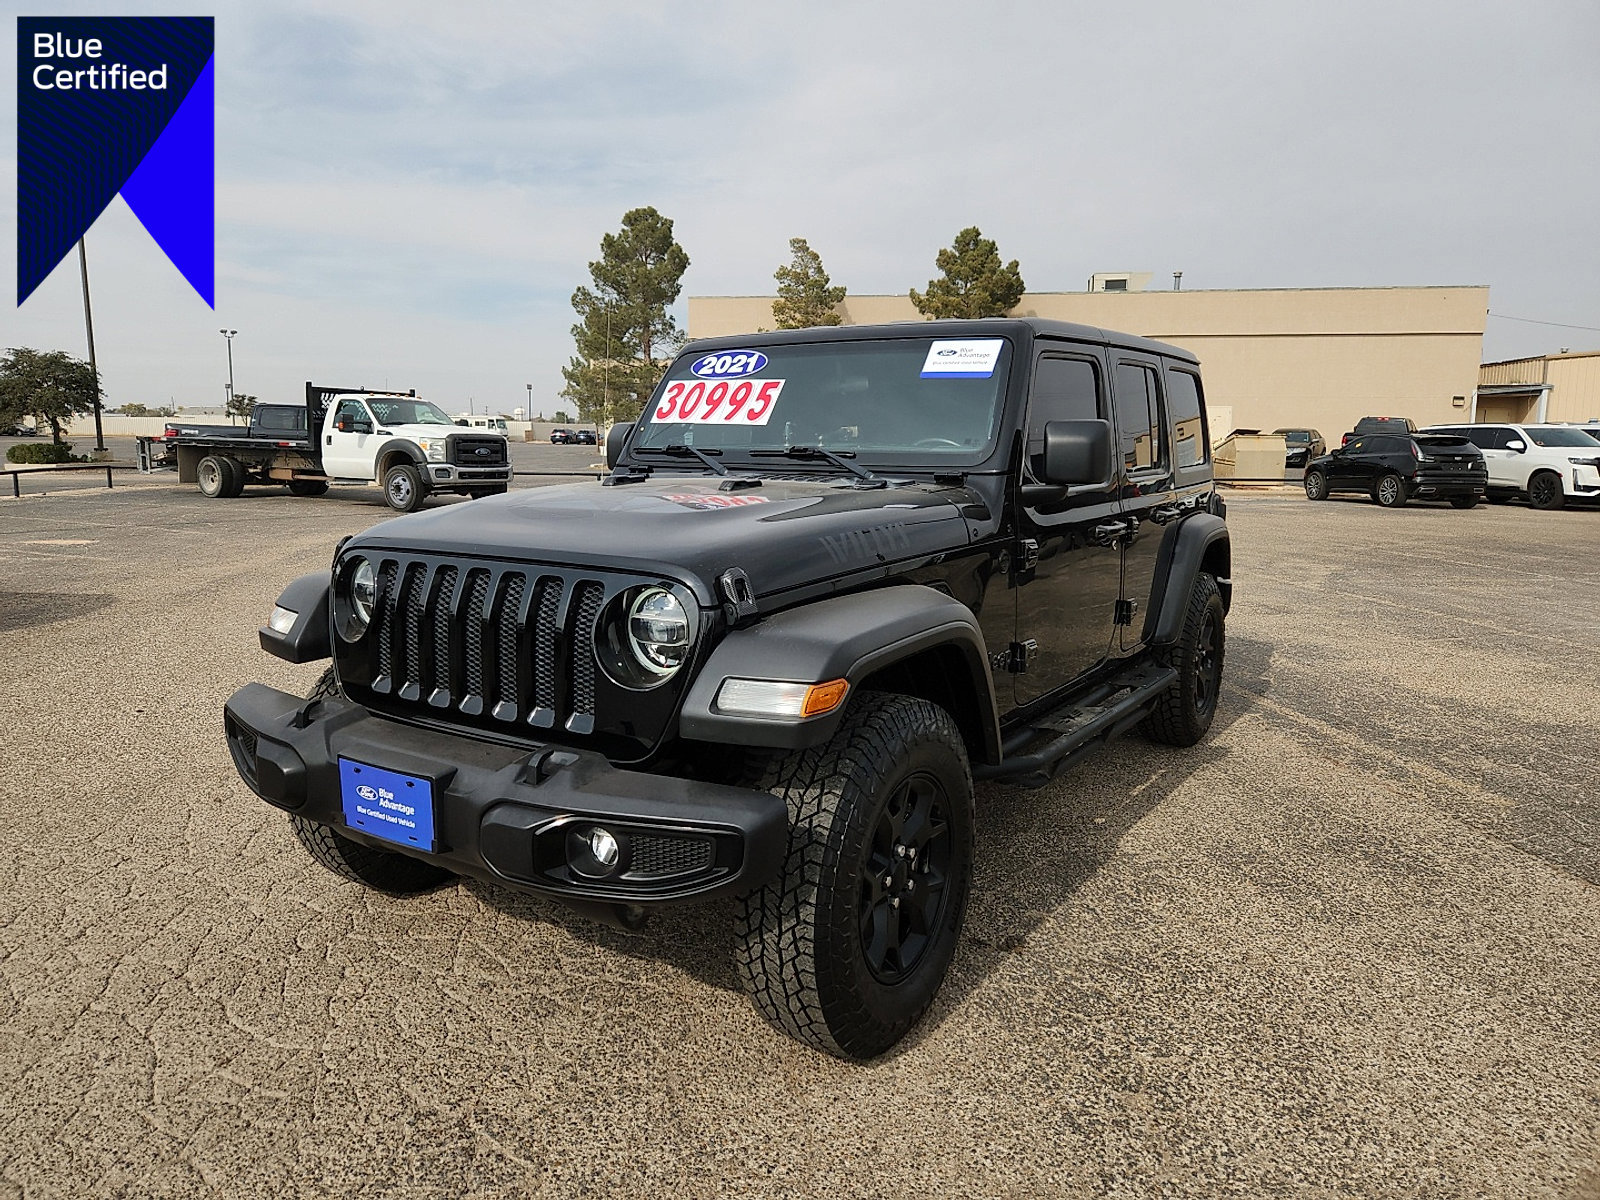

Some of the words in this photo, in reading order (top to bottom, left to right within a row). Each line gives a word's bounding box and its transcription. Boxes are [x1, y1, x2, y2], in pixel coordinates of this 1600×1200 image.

[698, 354, 760, 375] 2021
[656, 382, 781, 421] 30995
[379, 788, 394, 799] Blue
[379, 798, 415, 815] Advantage
[367, 809, 386, 820] Certified
[386, 815, 397, 823] Used
[398, 818, 416, 828] Vehicle
